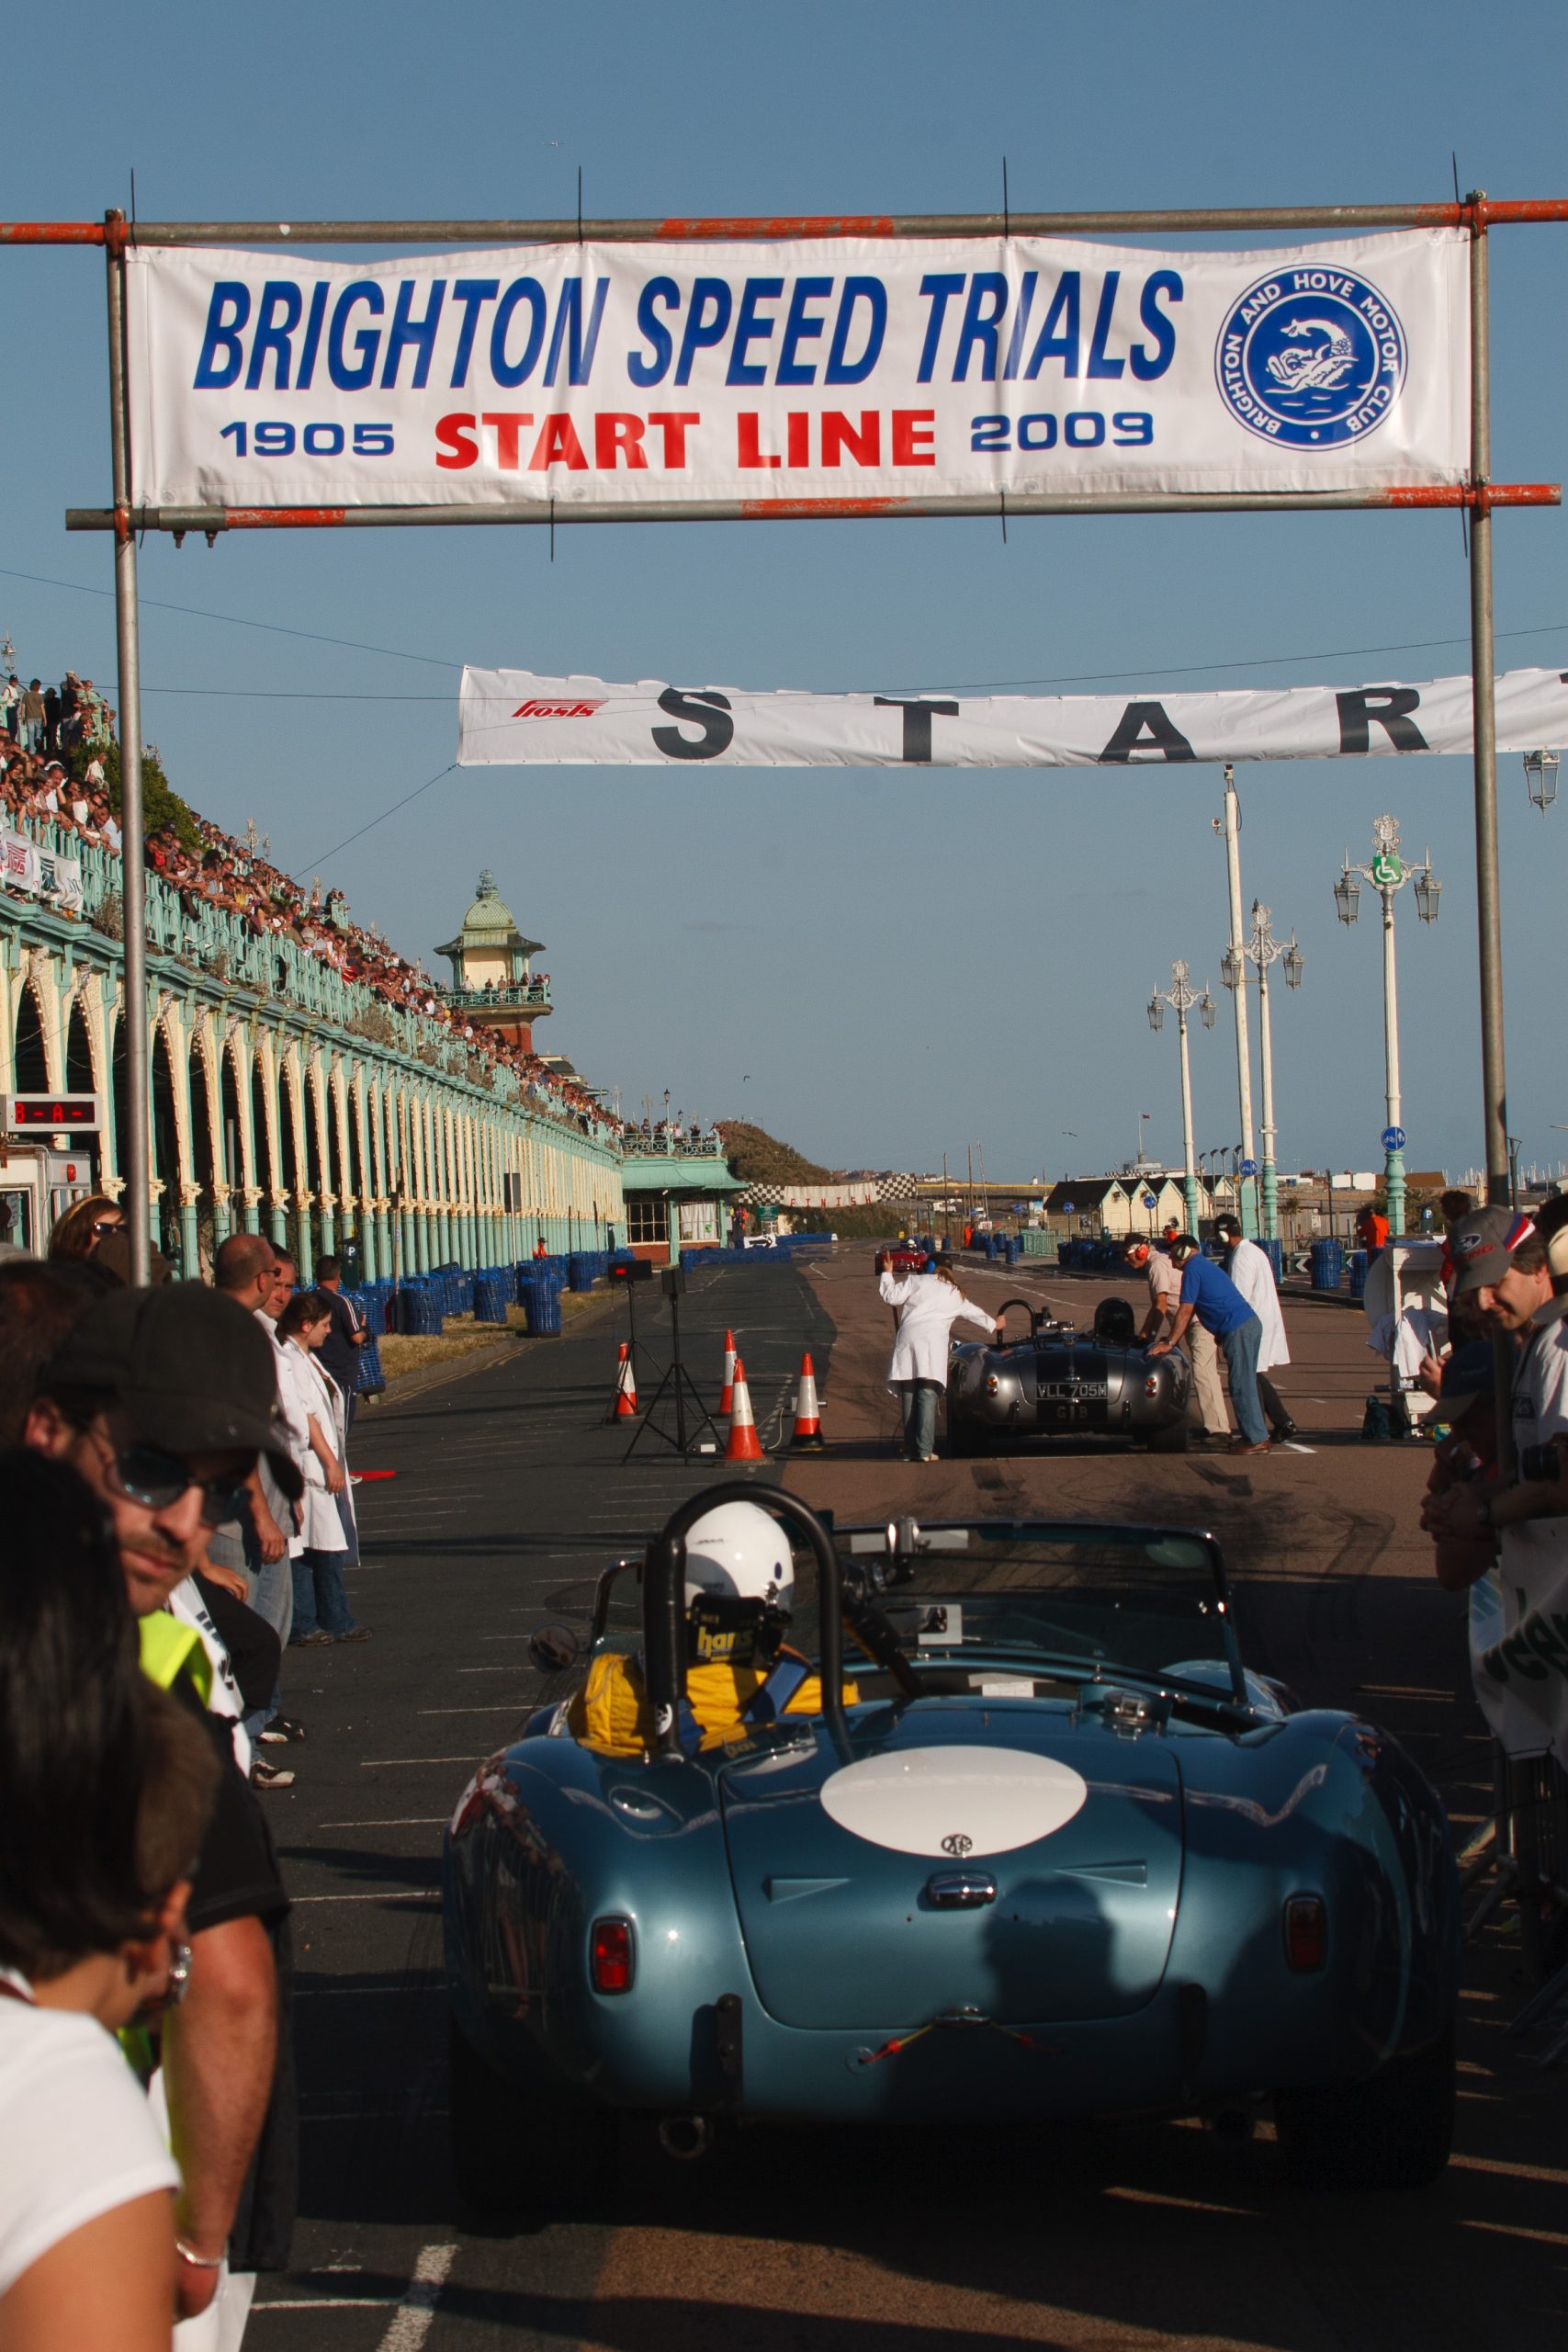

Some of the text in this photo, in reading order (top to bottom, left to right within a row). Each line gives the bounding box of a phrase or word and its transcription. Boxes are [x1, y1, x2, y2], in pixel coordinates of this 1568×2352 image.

[193, 269, 1184, 391] BRIGHTON SPEED TRIALS
[1224, 273, 1398, 435] BRIGHTON AND HOVE MOTOR CLUB
[220, 409, 1154, 471] 1905 START LINE 2009
[790, 1195, 871, 1208] FINISH
[348, 1246, 356, 1257] P
[1037, 1385, 1066, 1397] VLL
